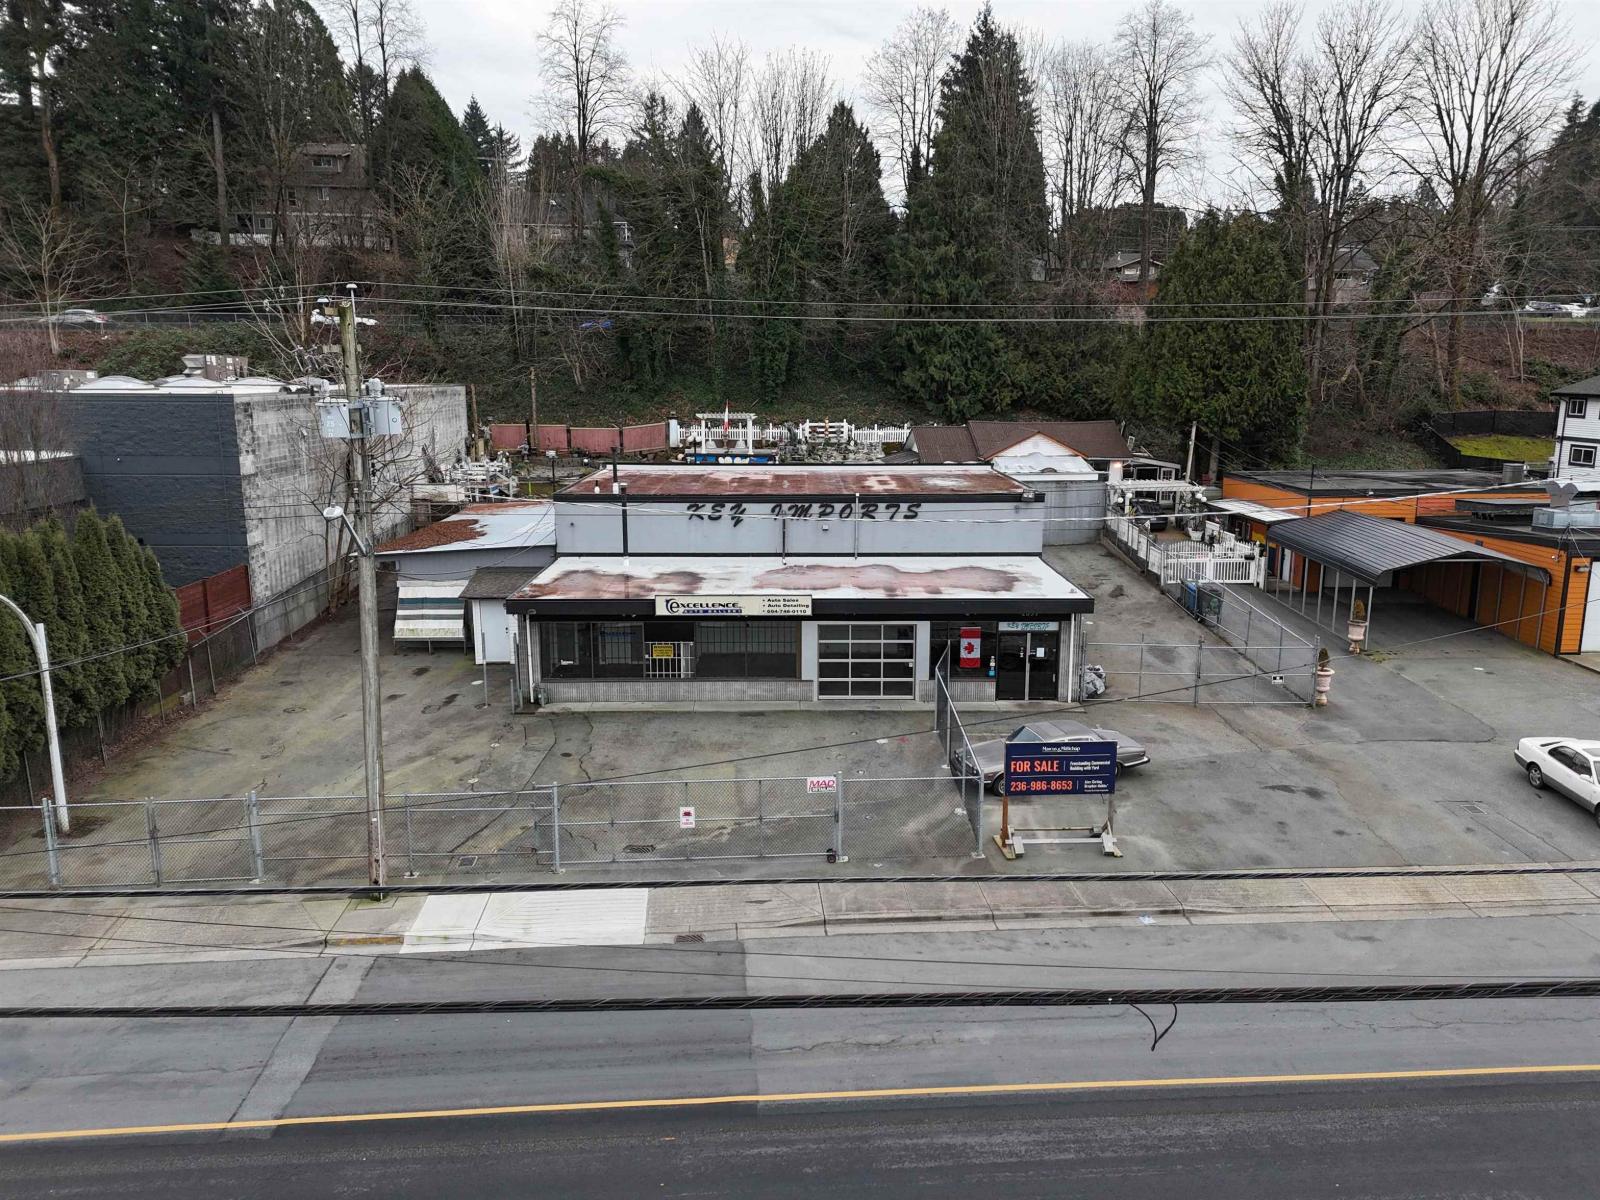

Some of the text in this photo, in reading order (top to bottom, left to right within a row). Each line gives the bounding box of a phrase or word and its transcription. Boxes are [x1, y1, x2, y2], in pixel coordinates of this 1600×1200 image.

[686, 503, 922, 528] KEY IMPORTS
[1010, 760, 1059, 772] FOR SALE
[810, 779, 836, 788] MAD
[1010, 780, 1073, 792] 236-986-8653
